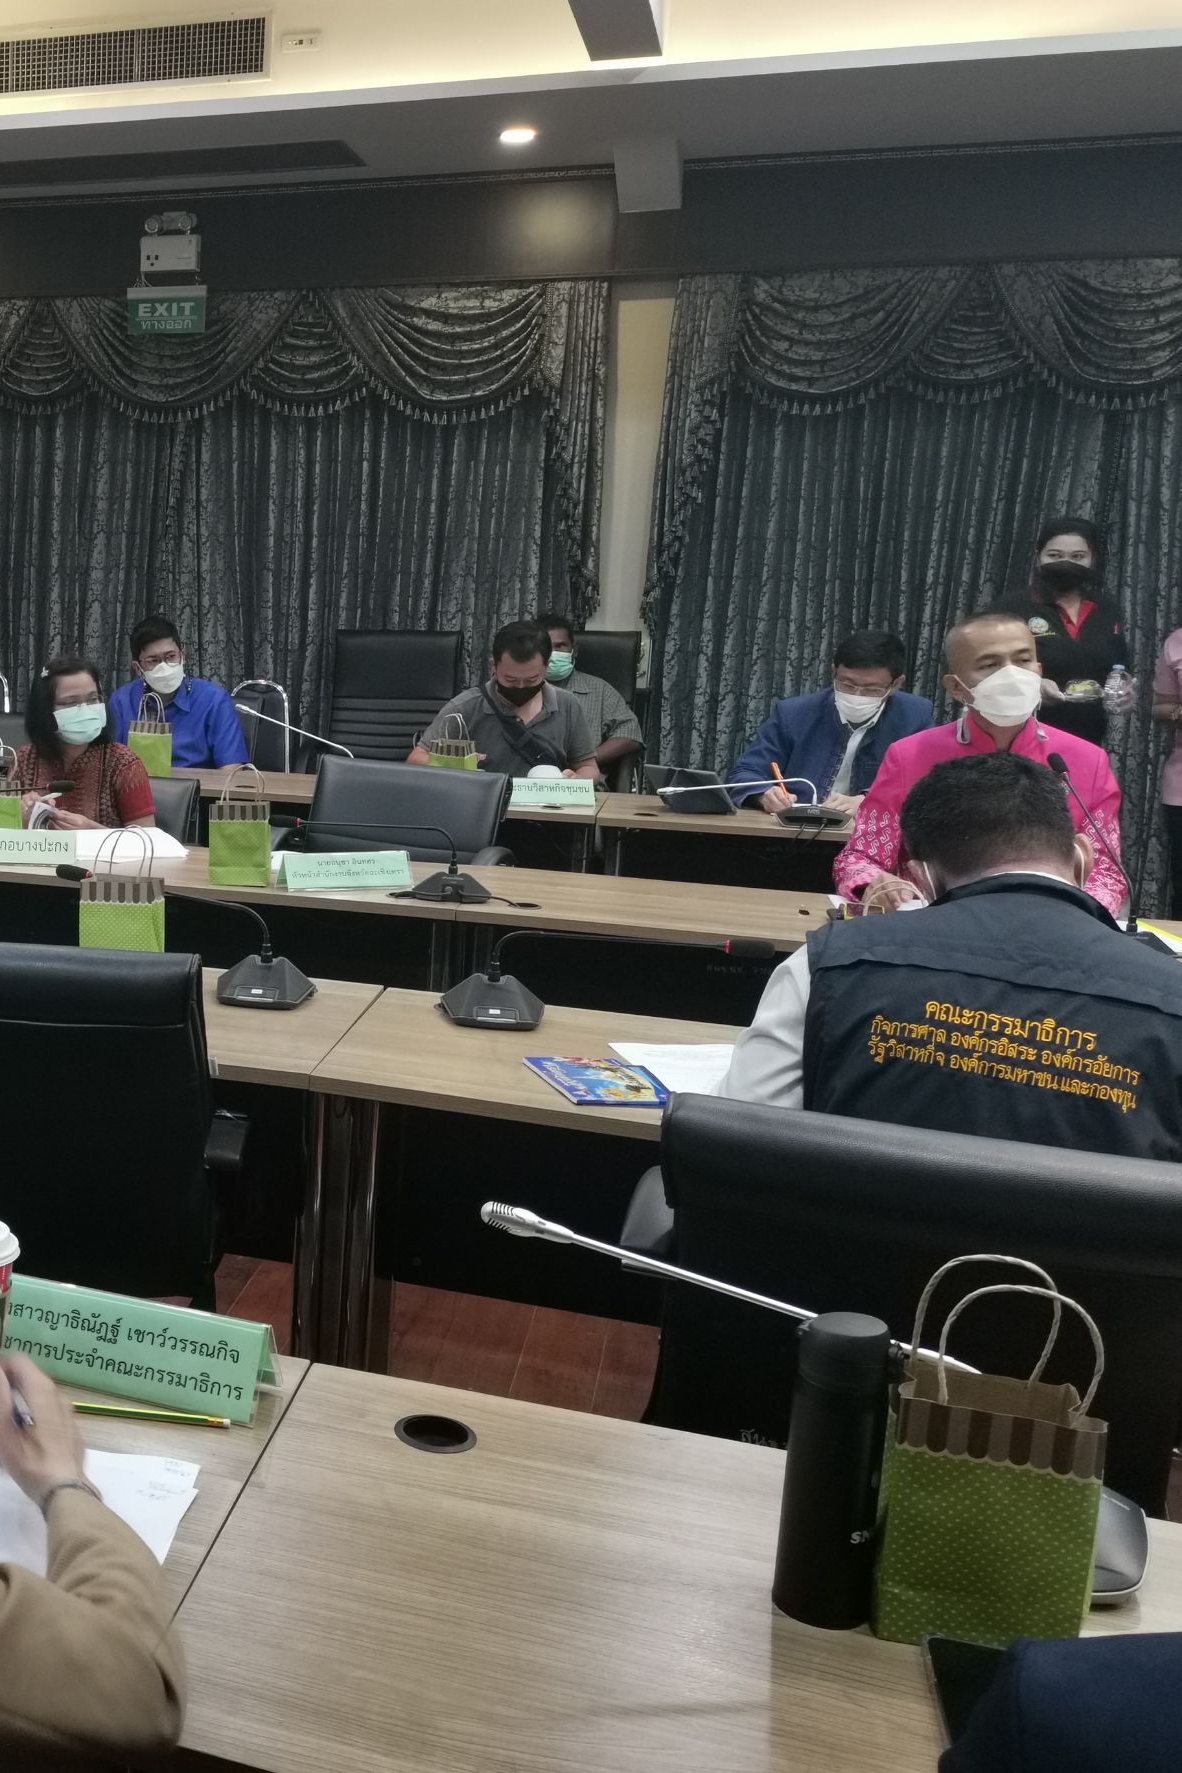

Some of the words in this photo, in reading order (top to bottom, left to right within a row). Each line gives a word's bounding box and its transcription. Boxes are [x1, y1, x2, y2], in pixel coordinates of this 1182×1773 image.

[138, 302, 195, 317] EXIT
[140, 319, 192, 330] ทางออก
[870, 1015, 947, 1043] กิจการศาล
[951, 1030, 1038, 1062] องค์กรอิสระ
[1041, 1048, 1141, 1086] องค์กรอัยการ
[925, 1000, 1098, 1051] คณะกรรมาธิการ
[868, 1037, 945, 1065] รัฐวิสาหกิจ
[949, 1051, 1059, 1090] องค์การมหาชน
[1060, 1078, 1137, 1114] และกองทุน
[4, 1334, 244, 1401] ชาการประจำคณะกรรมาธิการ
[127, 1327, 241, 1365] เชาว์วรรณกิจ
